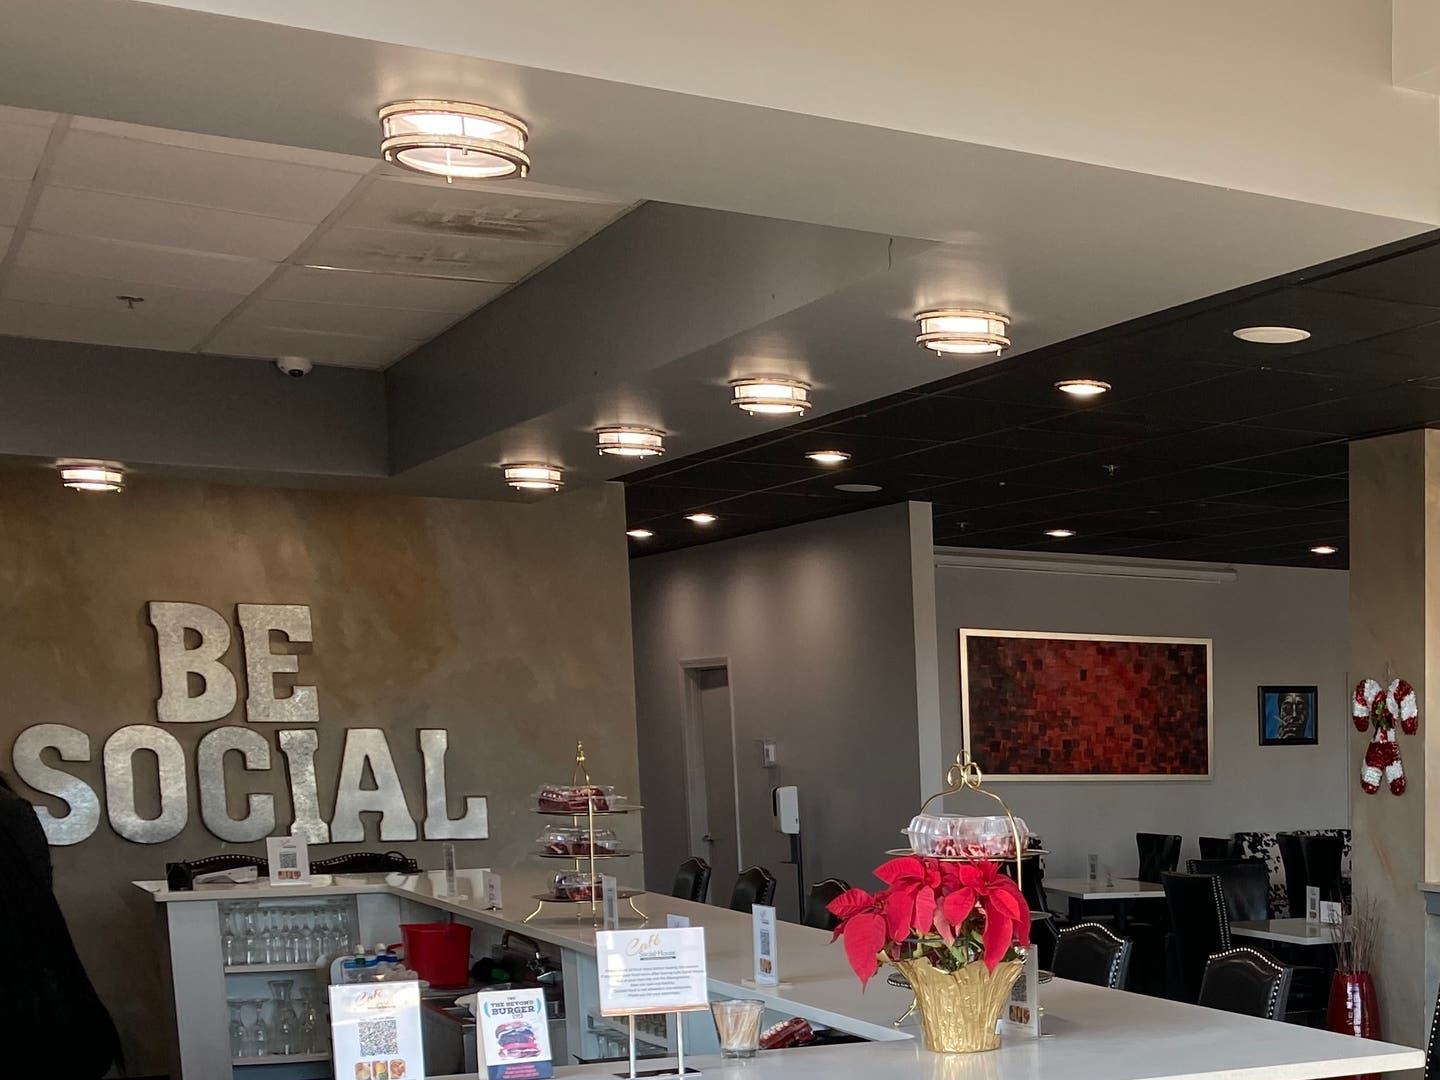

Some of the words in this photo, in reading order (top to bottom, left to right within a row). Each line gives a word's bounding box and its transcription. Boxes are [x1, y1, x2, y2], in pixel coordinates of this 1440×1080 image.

[149, 600, 320, 723] BE
[11, 722, 489, 846] SOCIAL
[491, 1005, 535, 1016] BURGER
